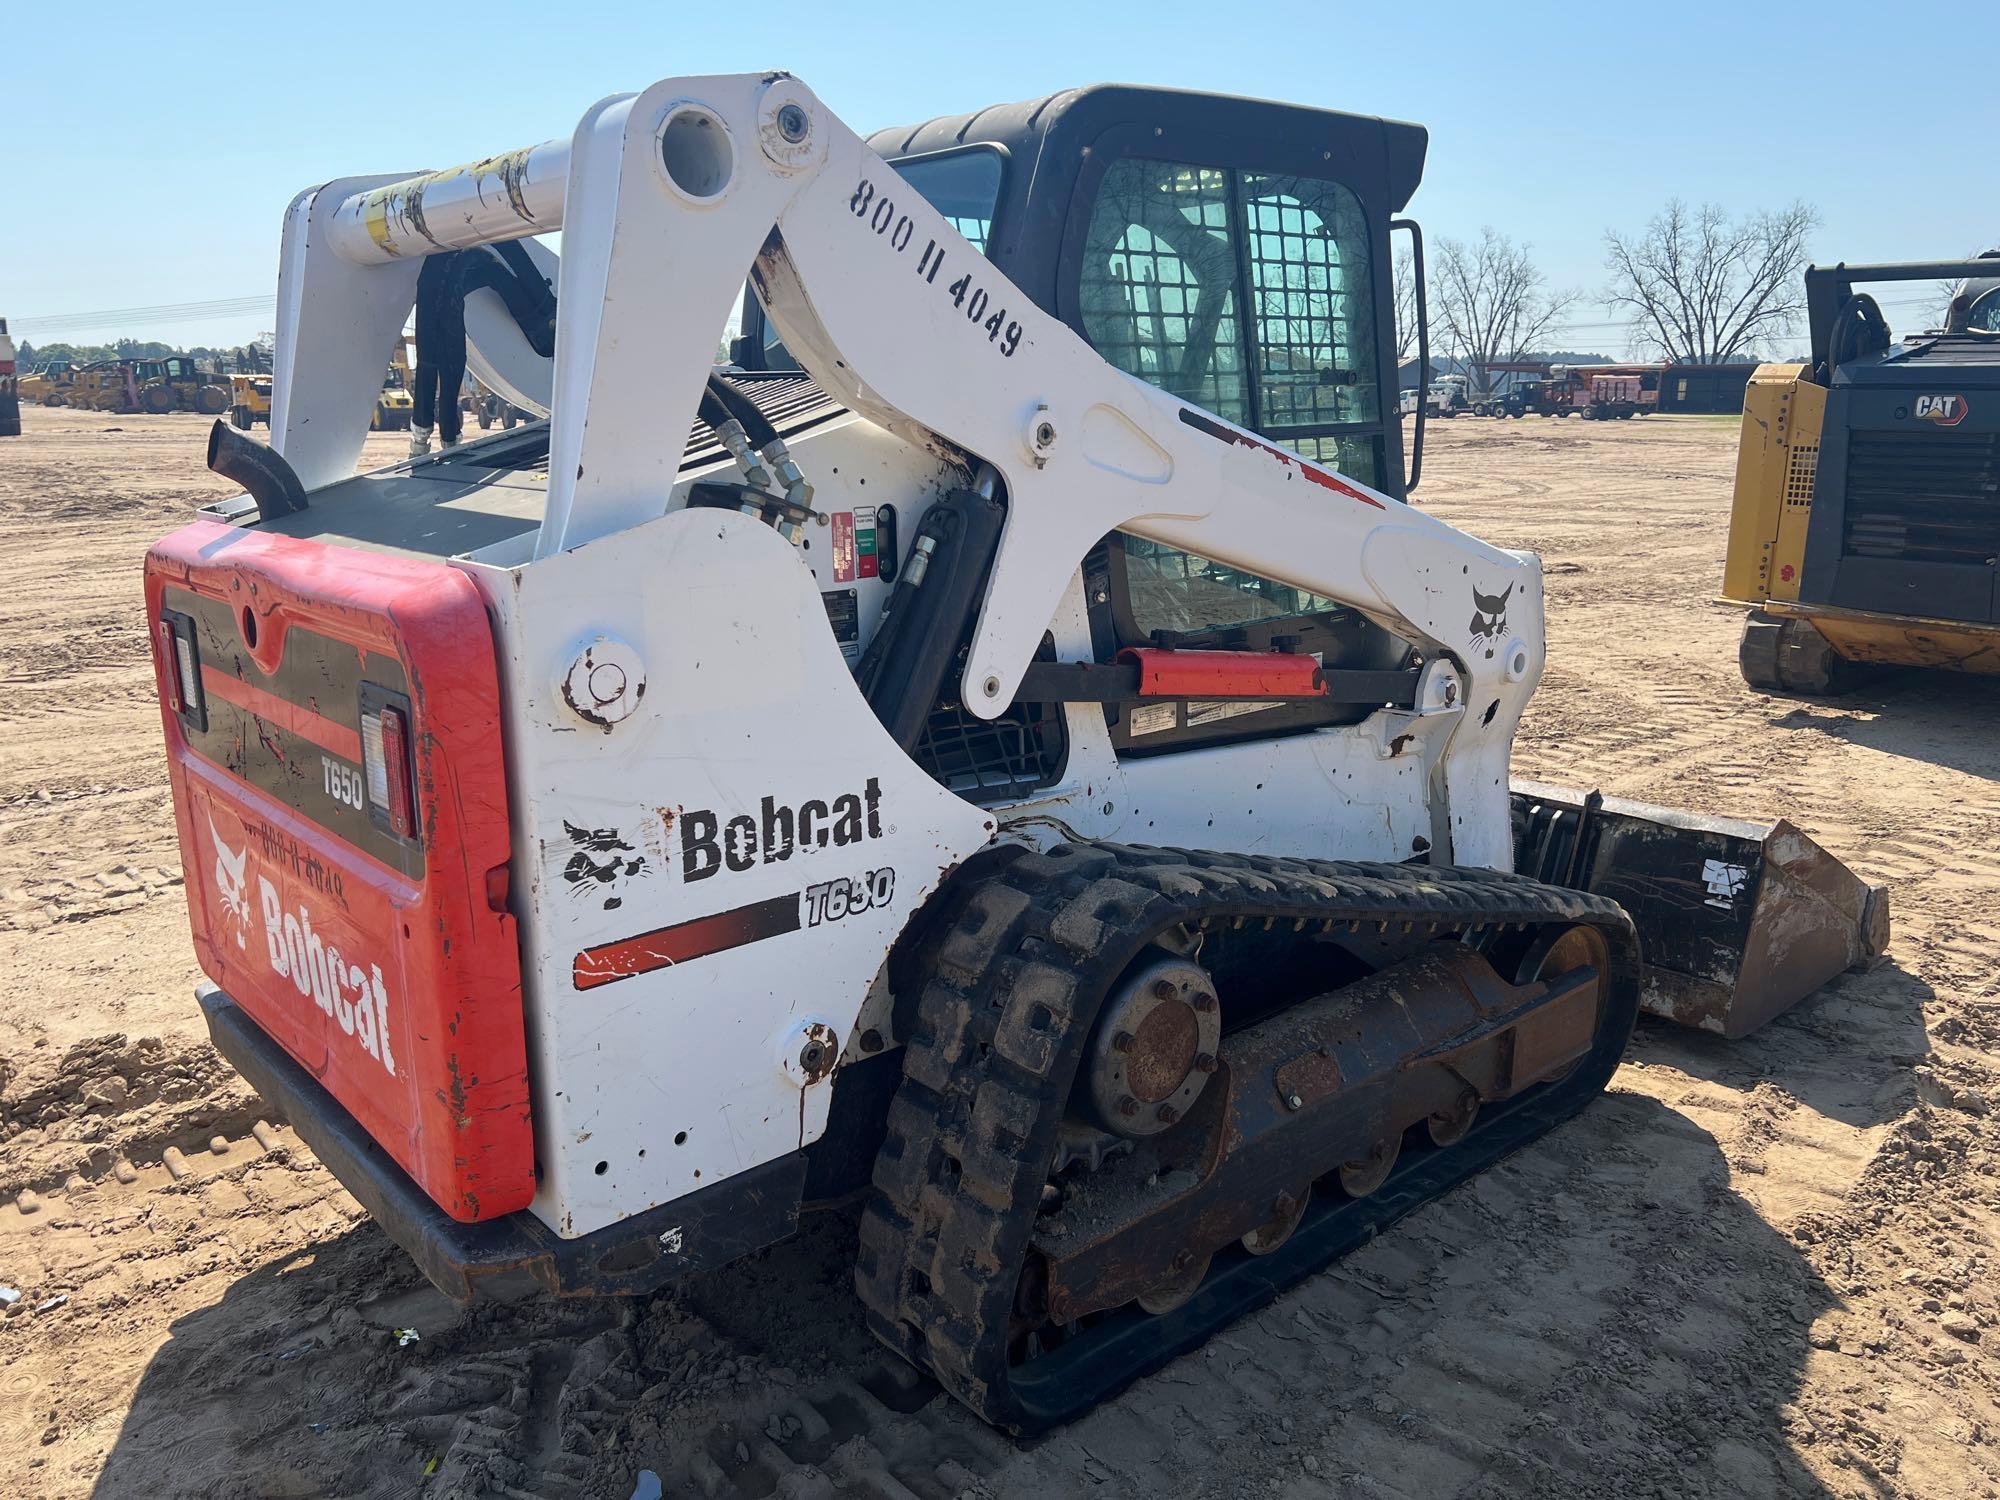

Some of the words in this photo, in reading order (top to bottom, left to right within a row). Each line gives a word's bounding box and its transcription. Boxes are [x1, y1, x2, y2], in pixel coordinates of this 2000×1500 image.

[850, 179, 914, 253] 800
[948, 273, 1023, 358] 4049
[1916, 395, 1956, 417] CAT
[321, 755, 363, 811] T650
[680, 777, 883, 884] Bobcat
[259, 875, 395, 1076] Bobcat
